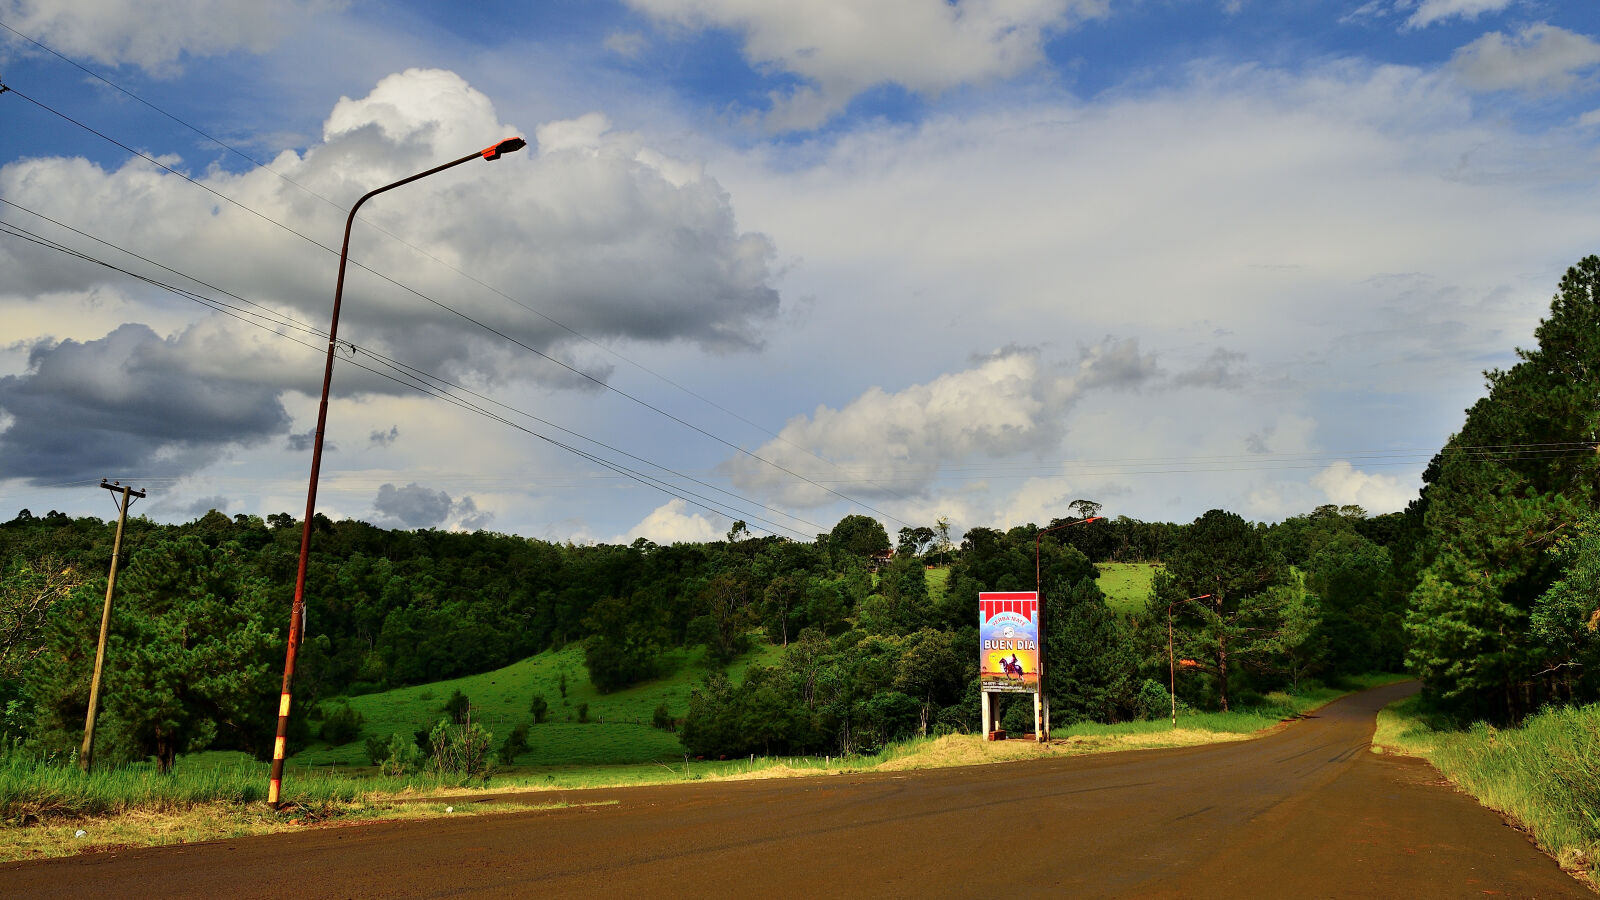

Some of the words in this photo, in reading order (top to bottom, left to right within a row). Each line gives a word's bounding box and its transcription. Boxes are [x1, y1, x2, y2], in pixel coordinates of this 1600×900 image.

[992, 616, 1010, 626] YERBA
[1011, 616, 1026, 627] MATE
[984, 640, 1013, 650] BUEN
[1017, 640, 1036, 650] DIA
